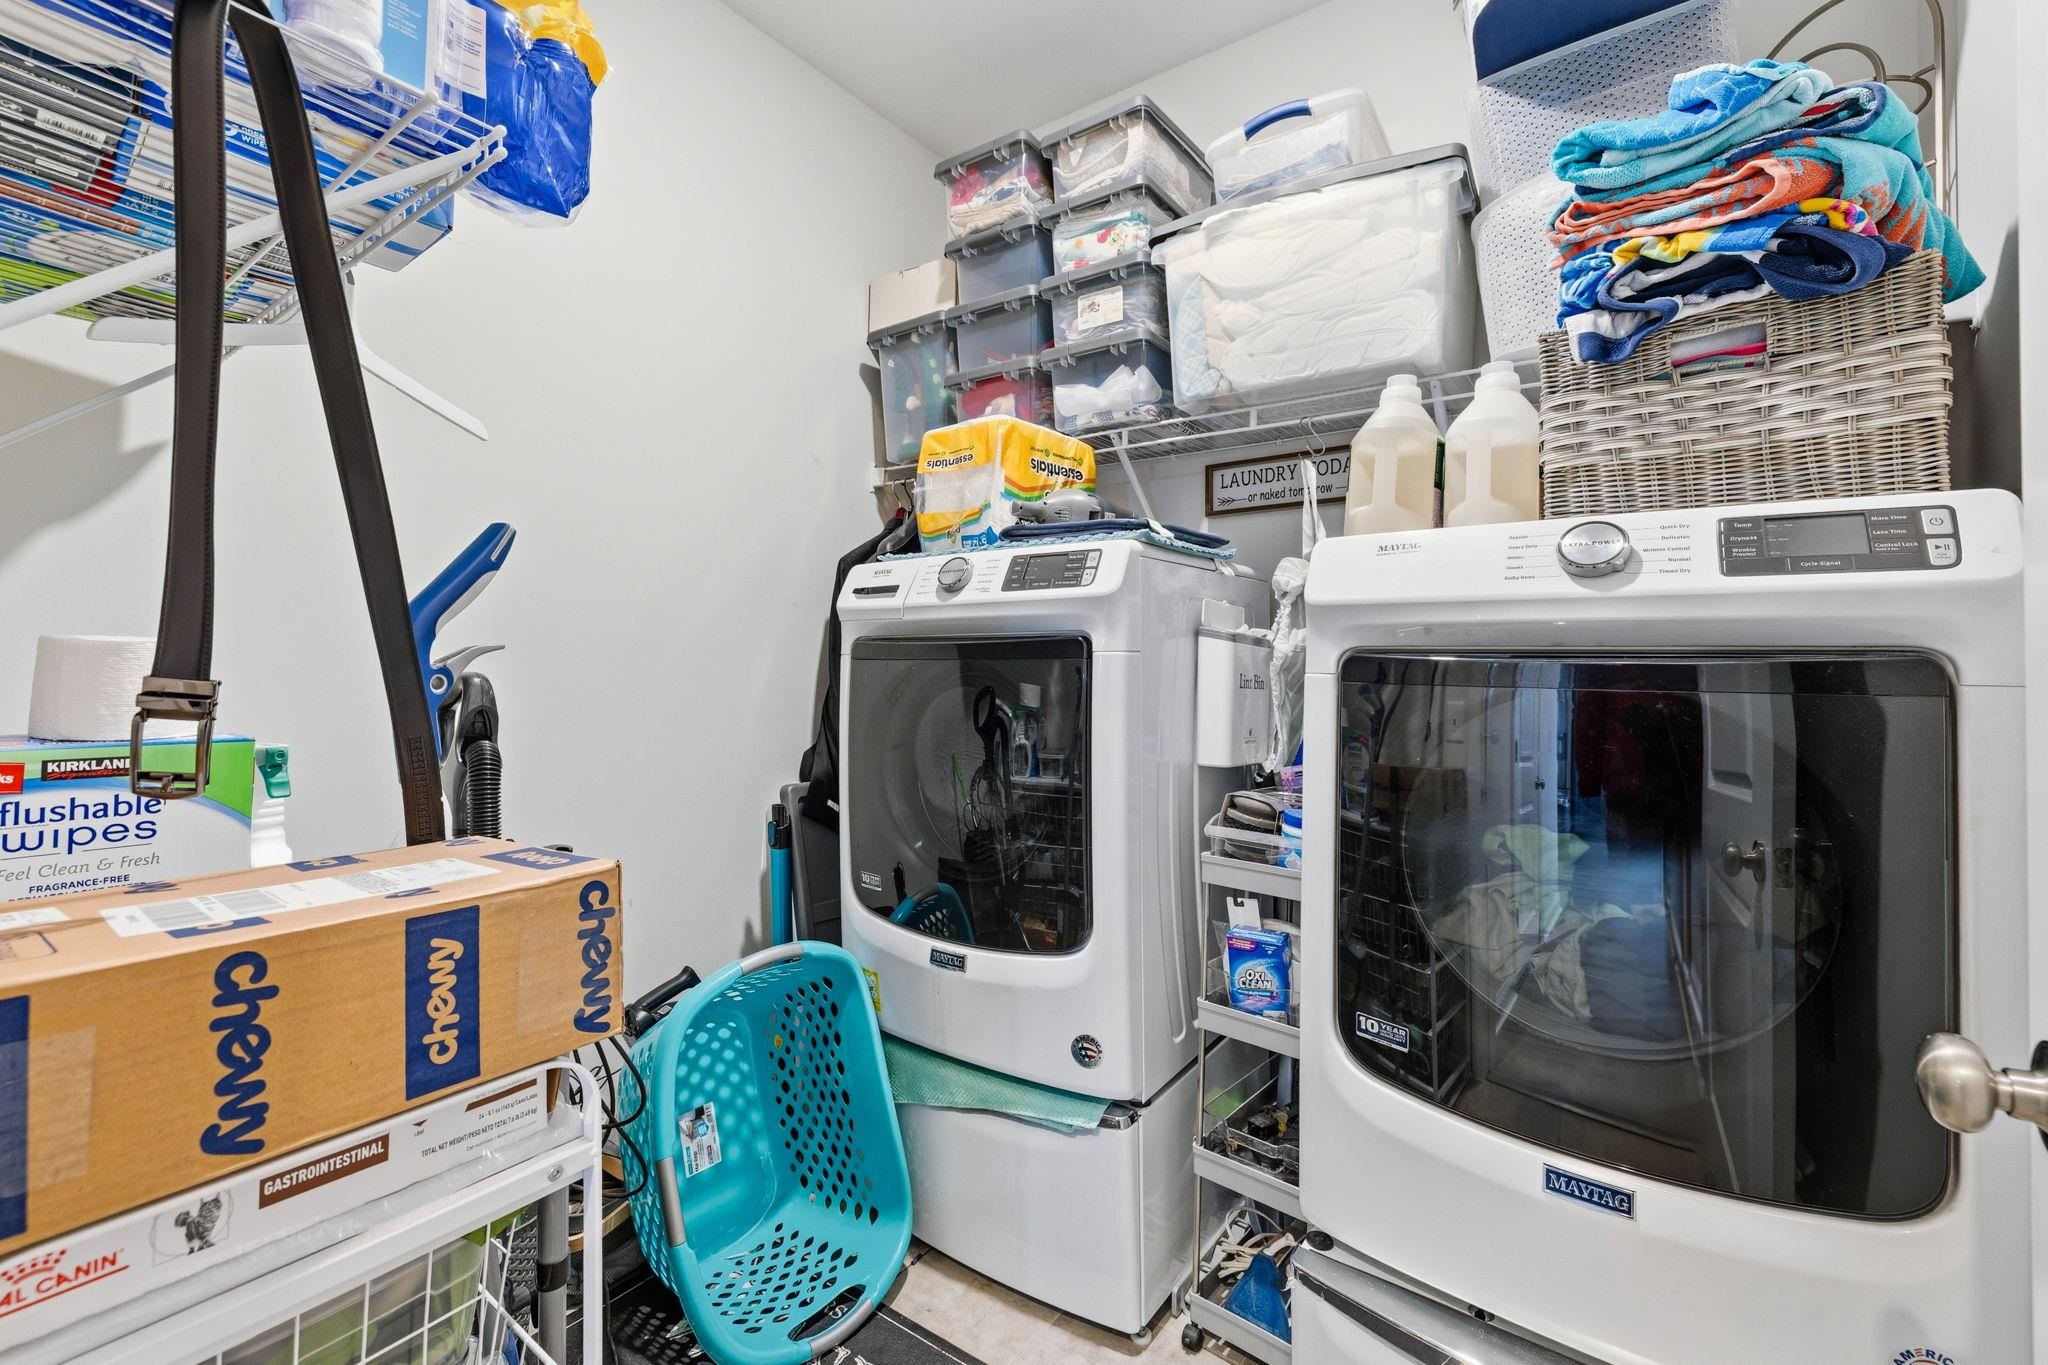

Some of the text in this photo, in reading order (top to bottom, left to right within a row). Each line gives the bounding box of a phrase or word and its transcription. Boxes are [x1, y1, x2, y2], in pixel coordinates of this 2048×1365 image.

[241, 133, 268, 150] WIPE
[926, 453, 974, 468] essentials
[1031, 457, 1083, 481] essentials
[1220, 456, 1350, 489] LAUNDRY ODA
[1247, 493, 1257, 503] or
[1260, 487, 1286, 501] naked
[1376, 543, 1421, 552] MAYTAG
[1239, 673, 1265, 690] Lint Bin
[0, 793, 162, 827] flushable
[2, 820, 157, 855] wipes
[38, 862, 90, 878] Clean
[97, 858, 114, 871] &
[120, 852, 160, 869] Fresh
[29, 874, 130, 894] FRAGRANCE-FREE
[573, 880, 616, 1034] chewy
[932, 951, 964, 967] MAYTAG
[1239, 977, 1273, 989] CLEAN
[1245, 969, 1266, 980] OXI
[422, 937, 465, 1066] chewy
[1359, 1016, 1379, 1034] 10
[1380, 1023, 1406, 1037] YEAR
[200, 951, 280, 1156] chewy
[421, 1146, 437, 1157] TOTAL
[438, 1141, 448, 1151] NET
[263, 1140, 385, 1196] GASTROINTESTINAL
[1548, 1172, 1630, 1212] MAYTAG
[36, 1252, 117, 1293] CANIN
